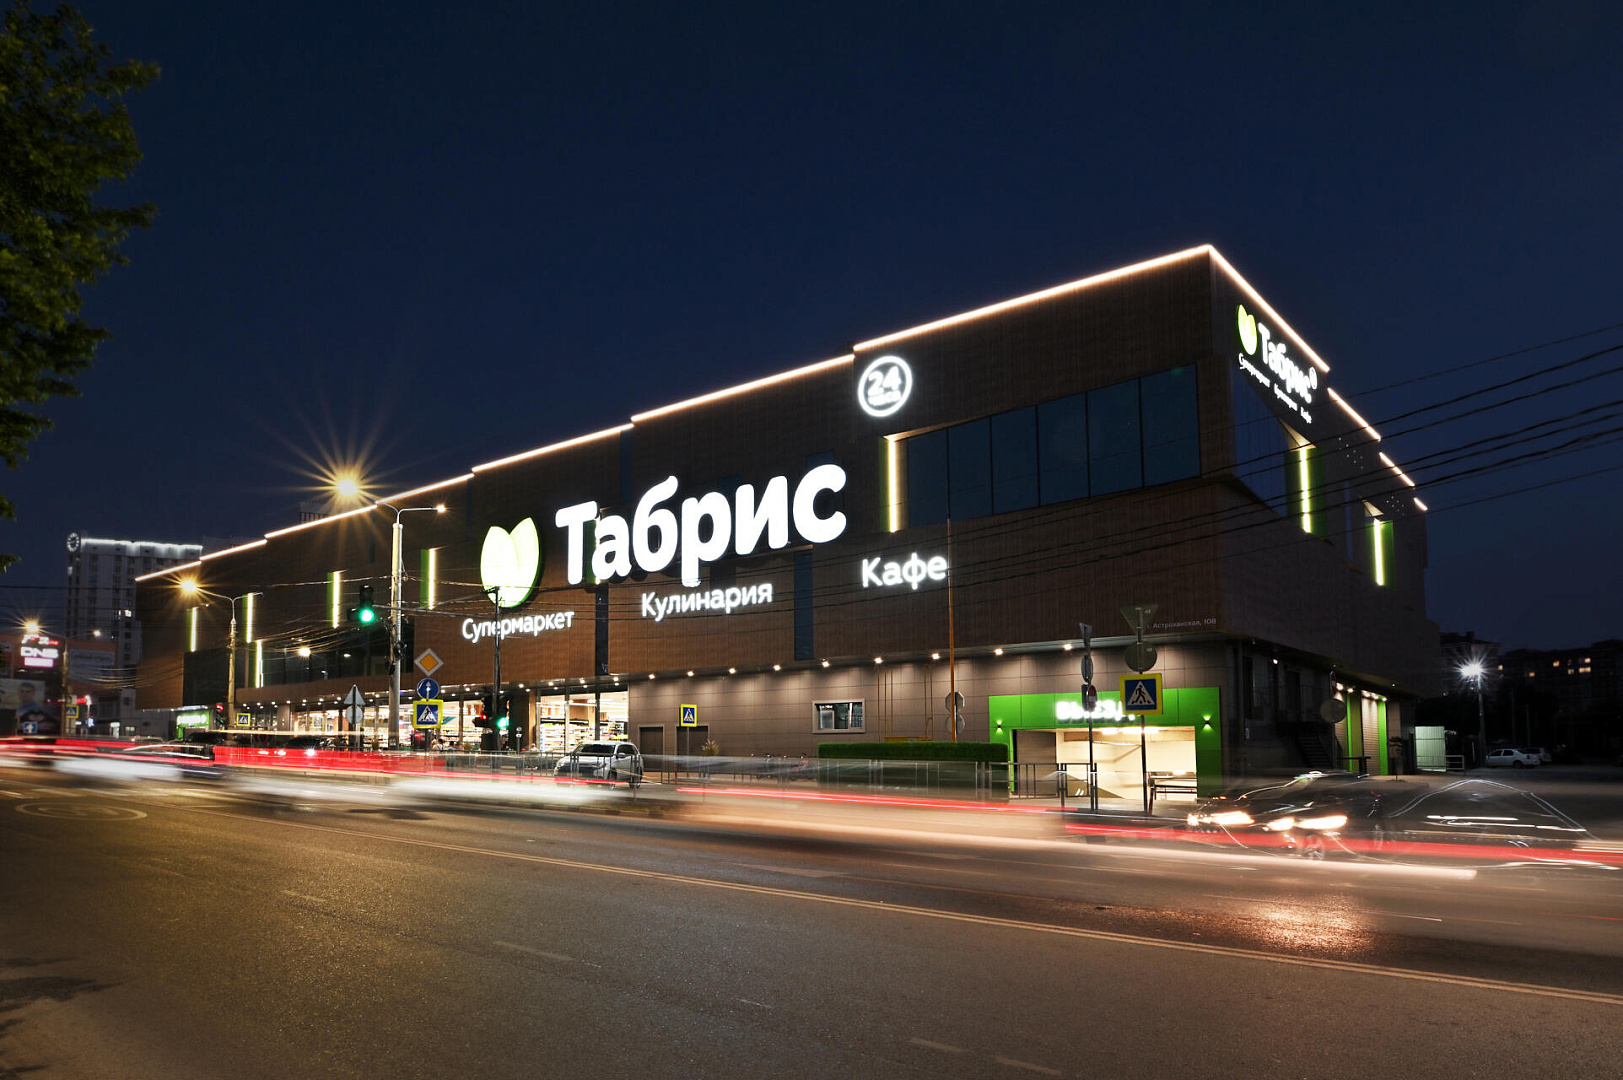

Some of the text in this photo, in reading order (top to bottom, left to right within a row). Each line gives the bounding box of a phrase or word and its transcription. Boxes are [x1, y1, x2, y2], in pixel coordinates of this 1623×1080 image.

[867, 365, 902, 396] 24
[555, 463, 848, 588] Табрис
[861, 551, 948, 590] Кафе
[641, 582, 773, 622] Кулинария
[461, 611, 575, 643] Супермаркет
